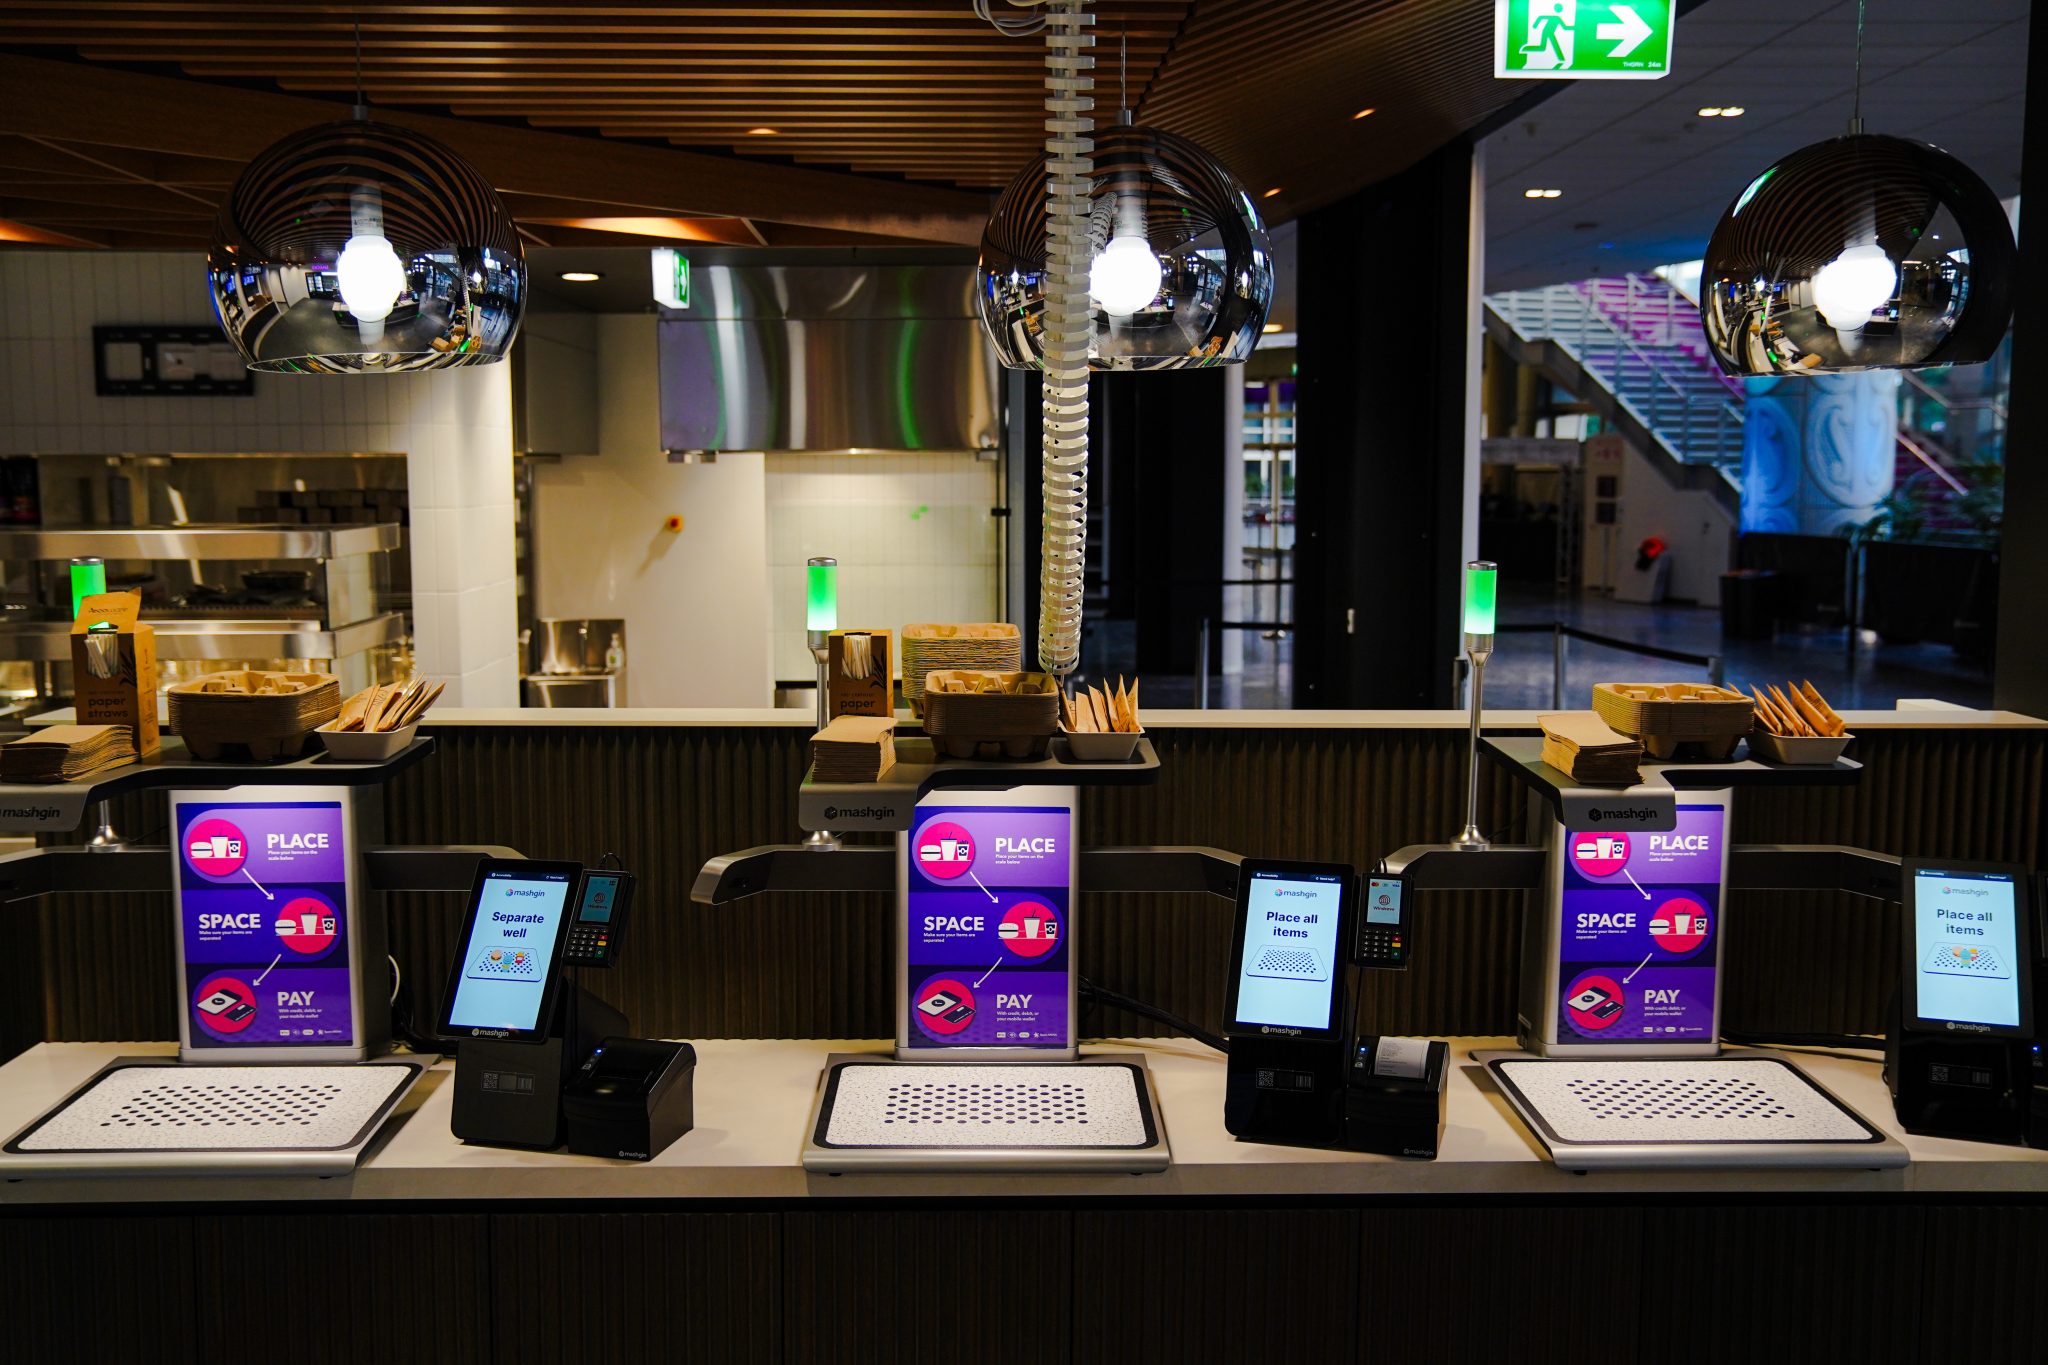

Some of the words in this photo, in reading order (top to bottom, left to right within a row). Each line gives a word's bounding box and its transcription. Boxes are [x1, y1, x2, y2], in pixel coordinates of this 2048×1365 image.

[88, 698, 126, 708] paper
[840, 700, 874, 710] paper
[88, 710, 128, 718] straws
[2, 806, 60, 820] mashgin
[840, 806, 894, 820] mashgin
[1603, 808, 1658, 821] mashgin
[267, 833, 329, 849] PLACE
[995, 837, 1056, 853] PLACE
[1650, 835, 1709, 850] PLACE
[514, 889, 545, 898] mashgin
[1283, 890, 1317, 899] mashgin
[1952, 888, 1989, 897] mashgin
[492, 912, 544, 924] Separate
[1266, 911, 1301, 923] Place
[1303, 914, 1318, 924] all
[1576, 913, 1636, 928] SPACE
[1937, 909, 1974, 921] Place
[1977, 912, 1992, 921] all
[198, 914, 261, 929] SPACE
[924, 916, 984, 931] SPACE
[503, 928, 527, 938] well
[1273, 927, 1308, 938] items
[1946, 924, 1984, 936] items
[277, 991, 314, 1006] PAY
[996, 994, 1032, 1008] PAY
[1644, 990, 1680, 1004] PAY
[479, 1029, 509, 1038] mashgin
[1270, 1026, 1302, 1036] mashgin
[1956, 1023, 1991, 1032] mashgin
